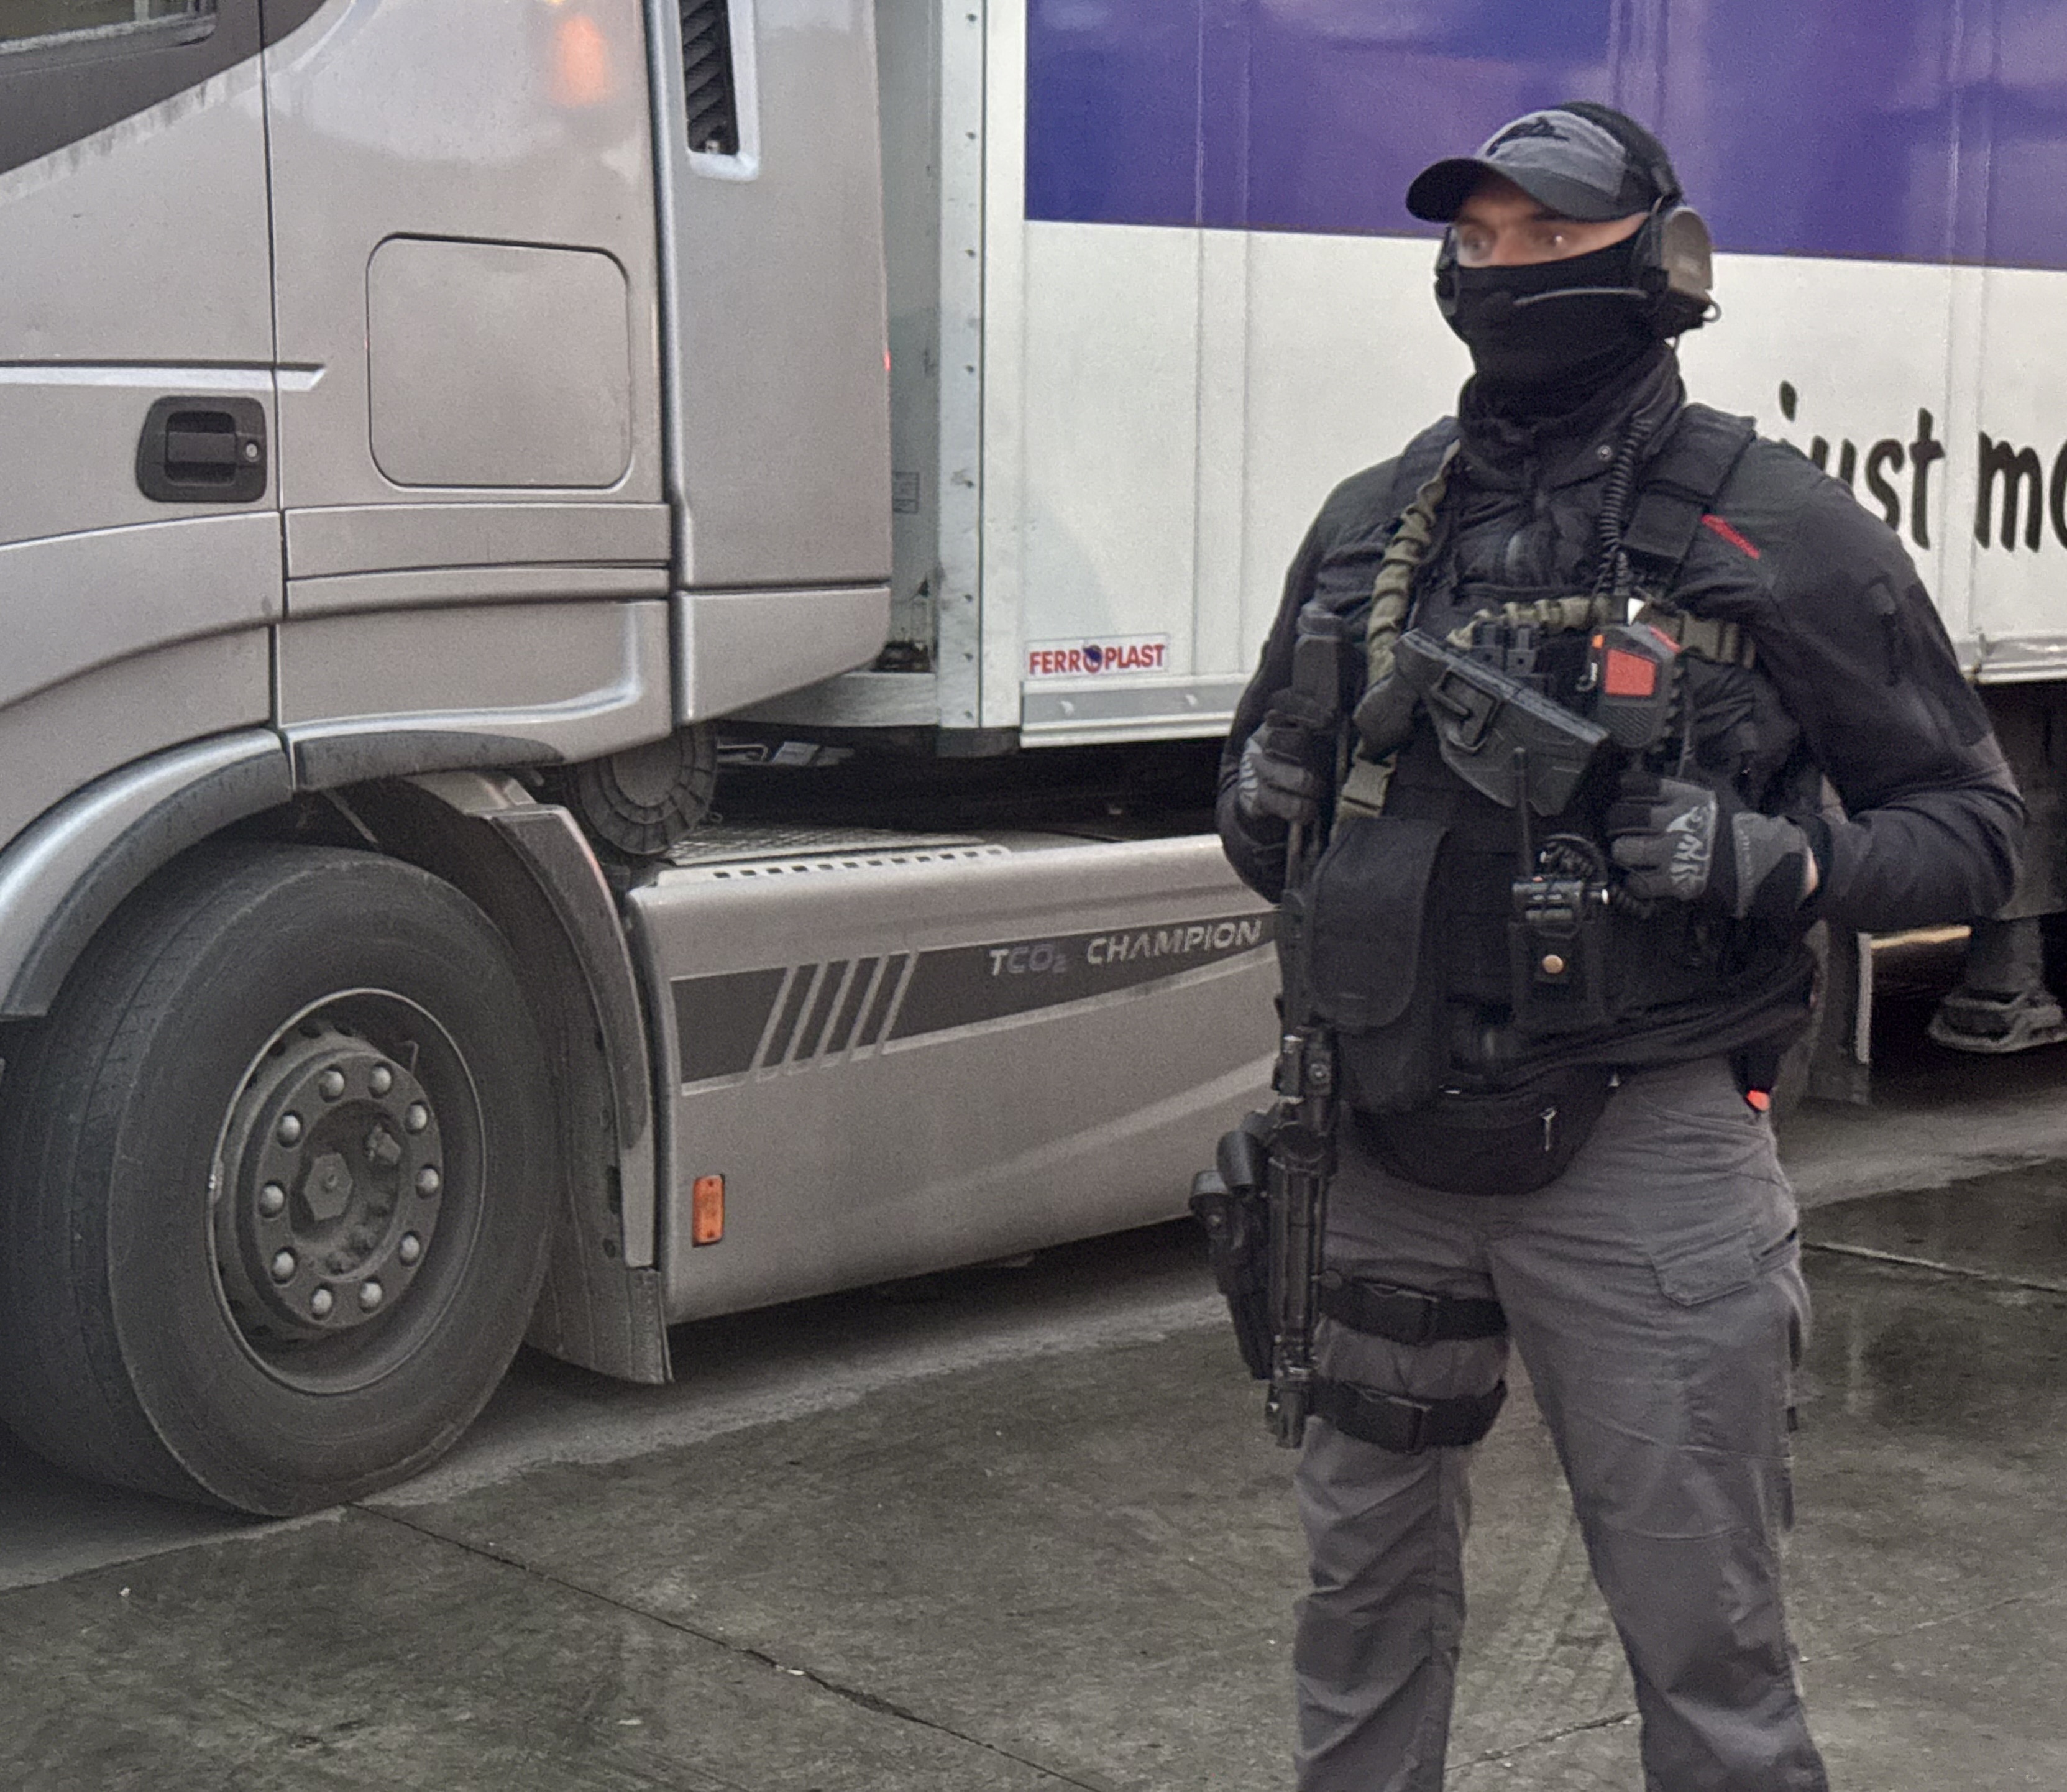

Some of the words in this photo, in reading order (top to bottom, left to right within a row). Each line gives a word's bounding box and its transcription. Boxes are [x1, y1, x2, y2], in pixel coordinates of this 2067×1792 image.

[1779, 380, 1945, 550] st
[1029, 643, 1166, 675] FERROPLAST
[1086, 919, 1262, 965] CHAMPION
